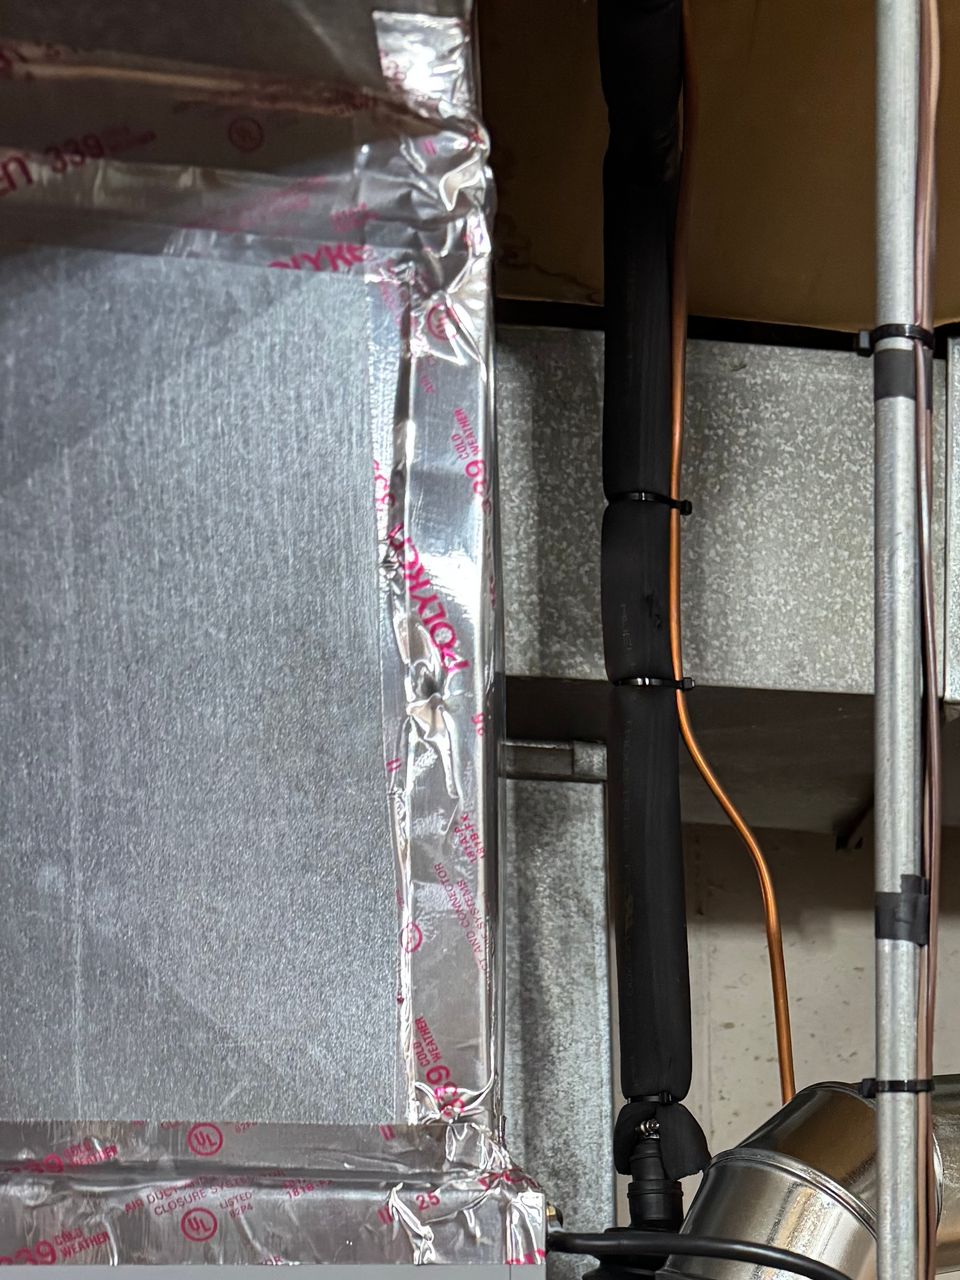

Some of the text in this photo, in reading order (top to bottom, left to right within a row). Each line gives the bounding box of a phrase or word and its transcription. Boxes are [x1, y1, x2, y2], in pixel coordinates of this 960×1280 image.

[453, 407, 481, 456] WEATHER
[434, 863, 470, 929] CONNECTOR
[415, 1015, 442, 1063] WEATHER
[413, 1041, 431, 1067] COLD
[124, 1199, 145, 1214] AIR
[146, 1185, 178, 1206] DUCT
[154, 1189, 208, 1216] CLOSURE
[219, 1191, 254, 1209] LISTED
[416, 1190, 441, 1211] 25
[61, 1231, 111, 1260] WEATHER
